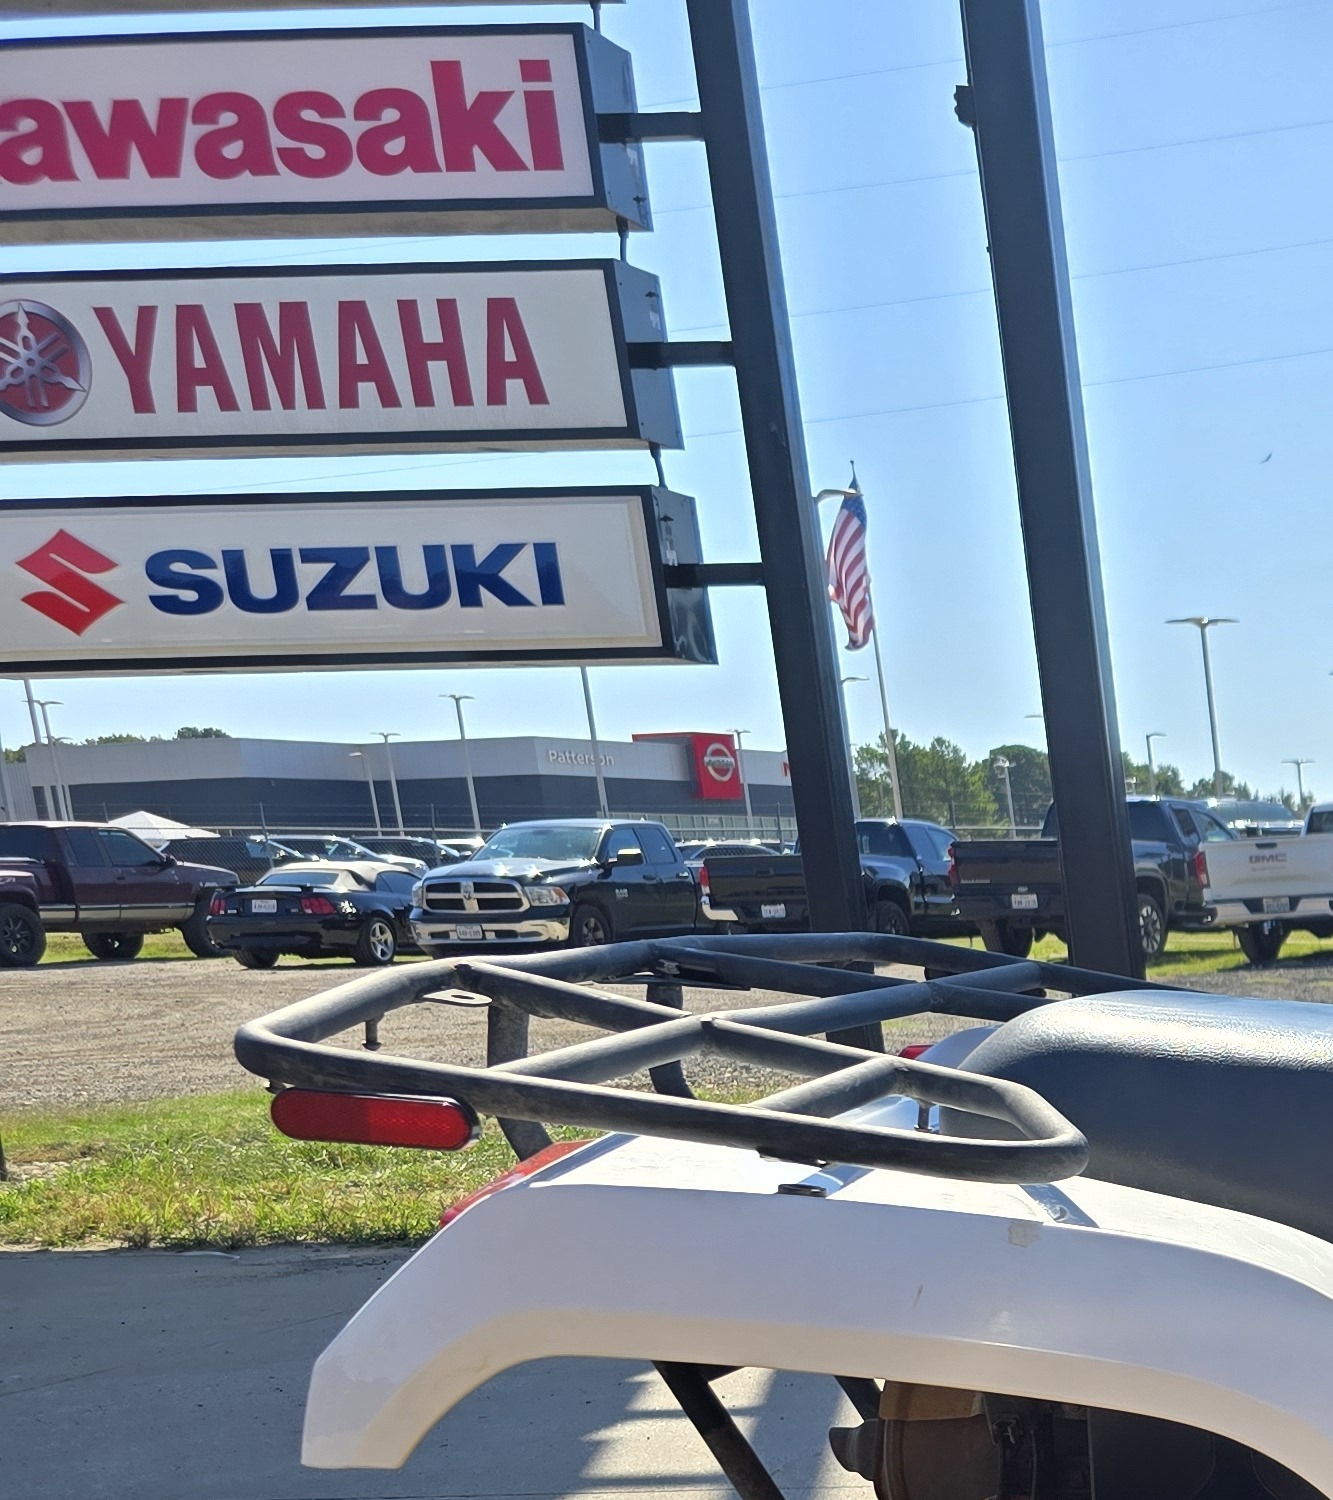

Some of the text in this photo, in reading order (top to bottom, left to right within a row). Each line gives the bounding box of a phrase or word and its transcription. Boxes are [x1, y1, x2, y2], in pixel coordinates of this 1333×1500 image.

[0, 59, 564, 184] awasaki
[92, 297, 550, 414] YAMAHA
[145, 541, 566, 614] SUZUKI
